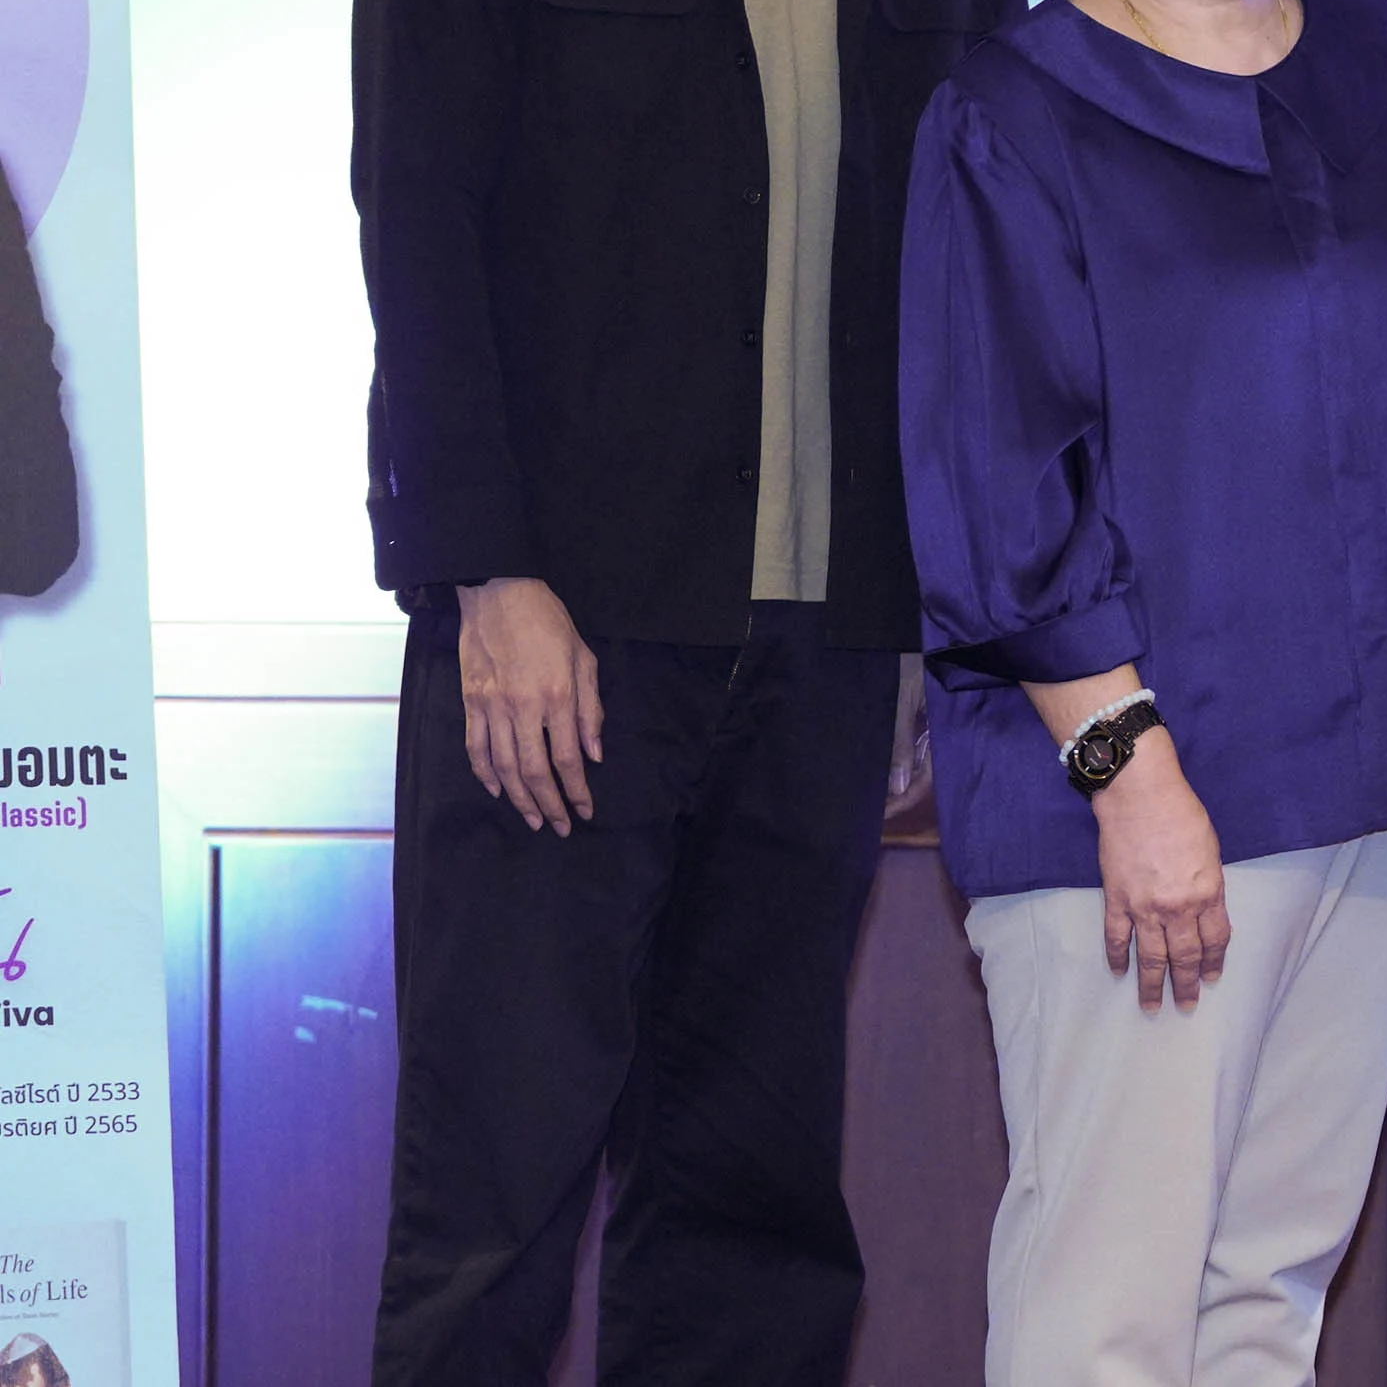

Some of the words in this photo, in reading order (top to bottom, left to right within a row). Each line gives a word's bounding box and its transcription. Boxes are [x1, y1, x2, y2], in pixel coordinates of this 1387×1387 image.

[0, 999, 54, 1027] iva
[0, 1083, 60, 1104] ลซีไรต์
[66, 1082, 80, 1103] ปี
[87, 1082, 140, 1102] 2533
[0, 1118, 57, 1137] รติยศ
[64, 1115, 77, 1135] ปี
[85, 1114, 138, 1134] 2565
[0, 1253, 35, 1274] The
[20, 1282, 42, 1307] of
[47, 1278, 88, 1301] Life
